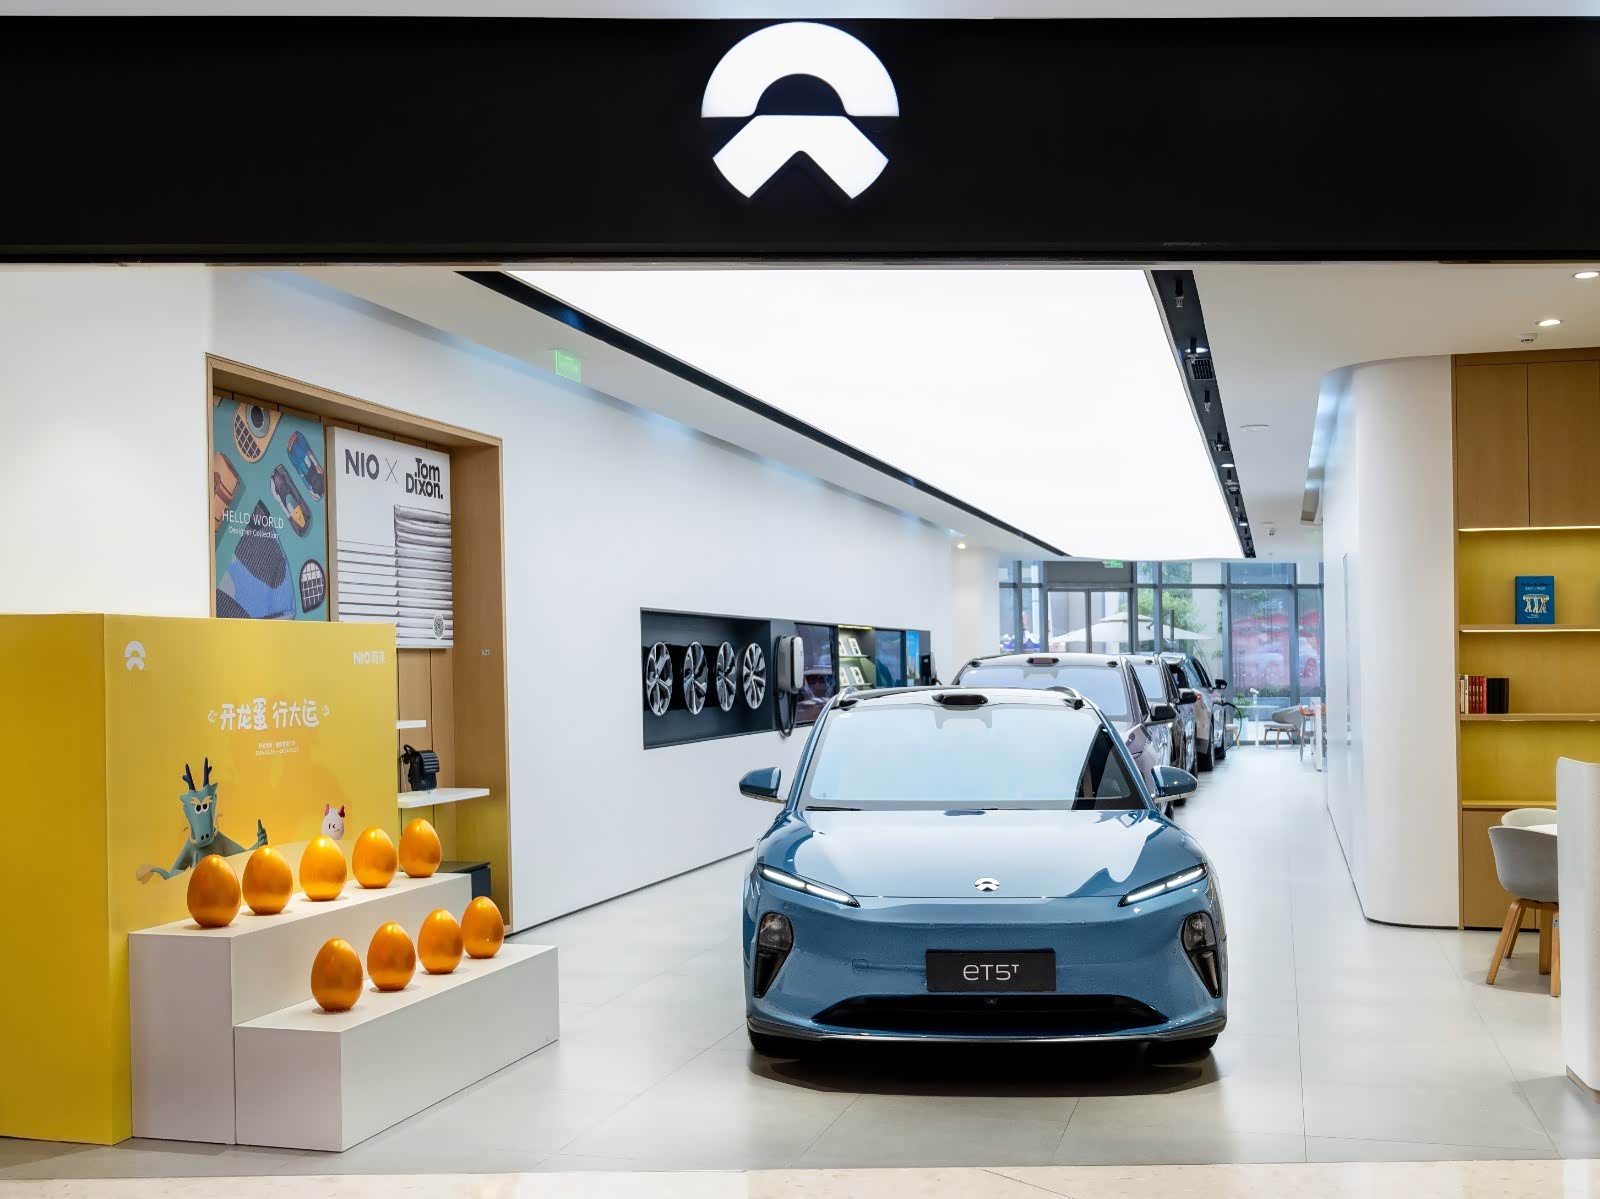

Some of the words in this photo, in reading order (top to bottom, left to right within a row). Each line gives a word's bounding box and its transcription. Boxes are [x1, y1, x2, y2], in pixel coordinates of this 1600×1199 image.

[345, 448, 380, 480] NIO
[415, 457, 440, 482] Tom
[405, 472, 444, 499] Dixon.
[222, 510, 250, 524] HELLO
[252, 514, 284, 529] WORLD
[229, 526, 251, 537] Designer
[252, 529, 279, 539] Collection
[353, 651, 370, 664] NIO
[272, 698, 320, 728] 行大运
